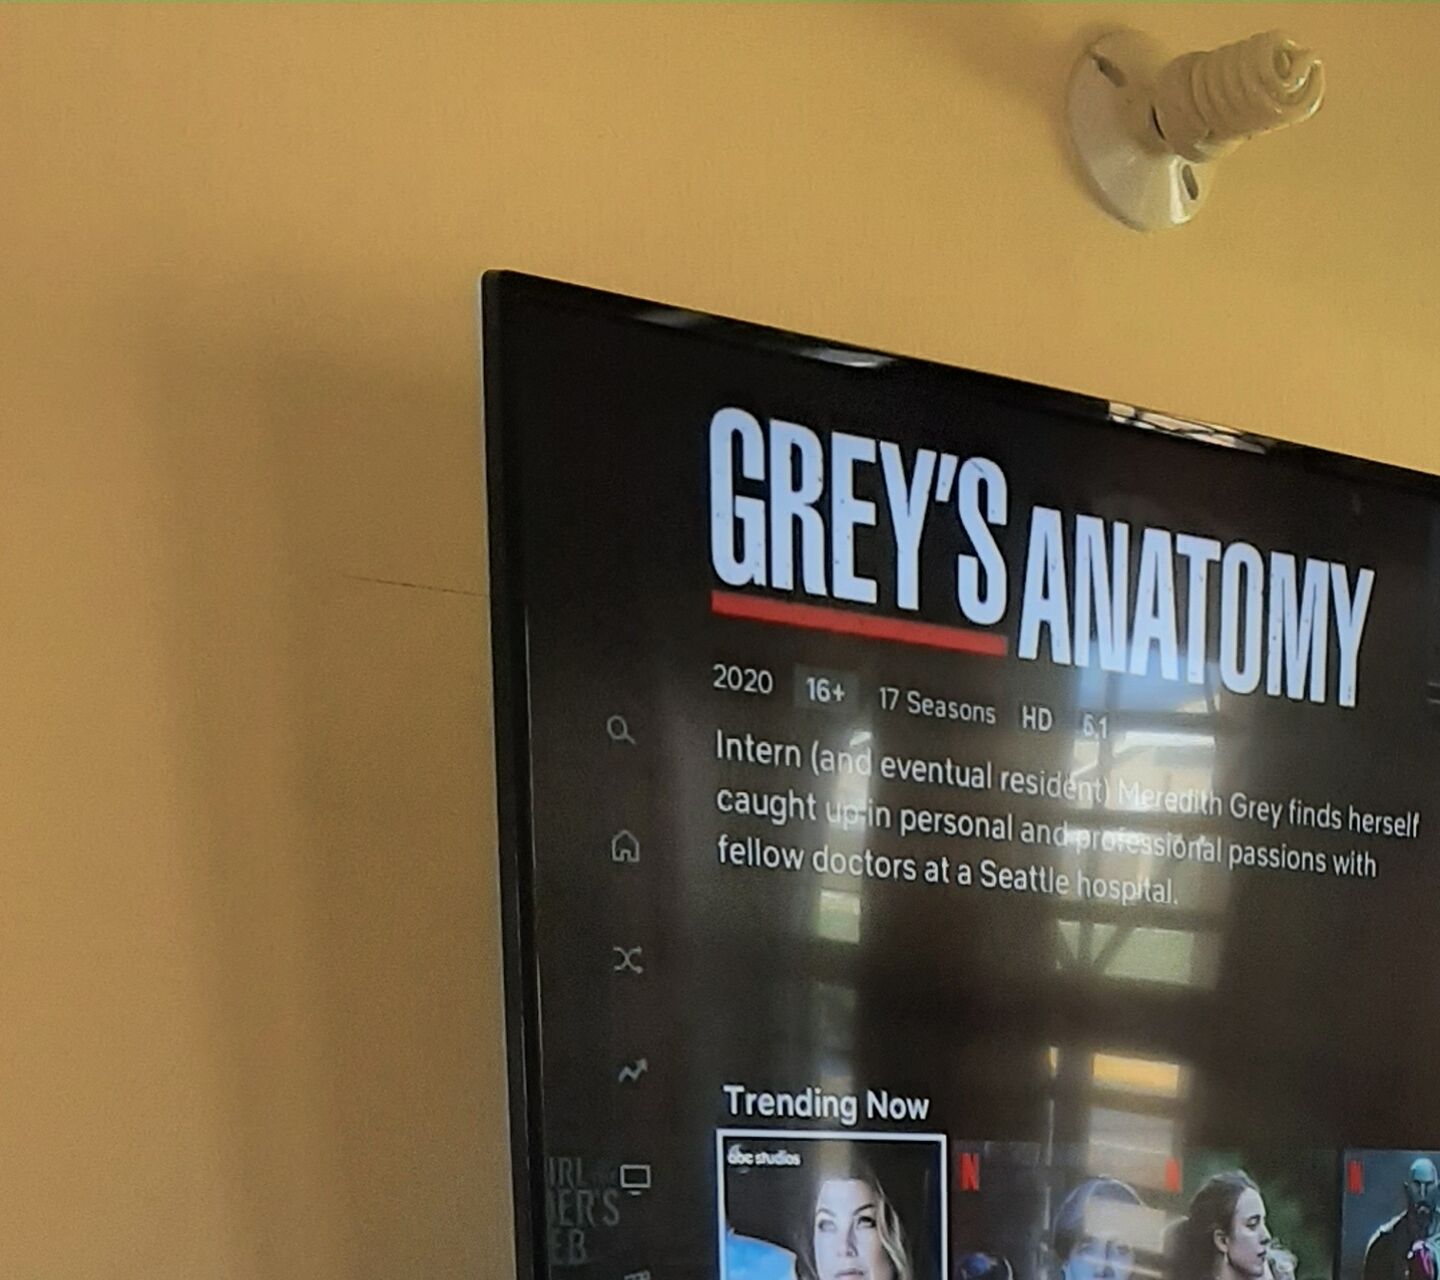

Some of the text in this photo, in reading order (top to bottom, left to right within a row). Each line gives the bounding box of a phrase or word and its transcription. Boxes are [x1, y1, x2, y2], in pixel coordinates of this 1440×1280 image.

[710, 406, 1375, 708] GREY'S ANATOMY
[713, 663, 774, 694] 2020
[806, 677, 846, 703] 16+
[879, 687, 900, 711] 17
[906, 691, 997, 725] Seasons
[1021, 705, 1053, 732] HD
[716, 729, 1421, 839] Intern (and eventual resident) Meredith Grey finds herself
[716, 788, 1377, 878] caught up in personal and professional passions with
[717, 832, 1178, 907] fellow doctors at a Seattle hospital.
[722, 1084, 930, 1126] Trending Now
[755, 1149, 801, 1166] studios
